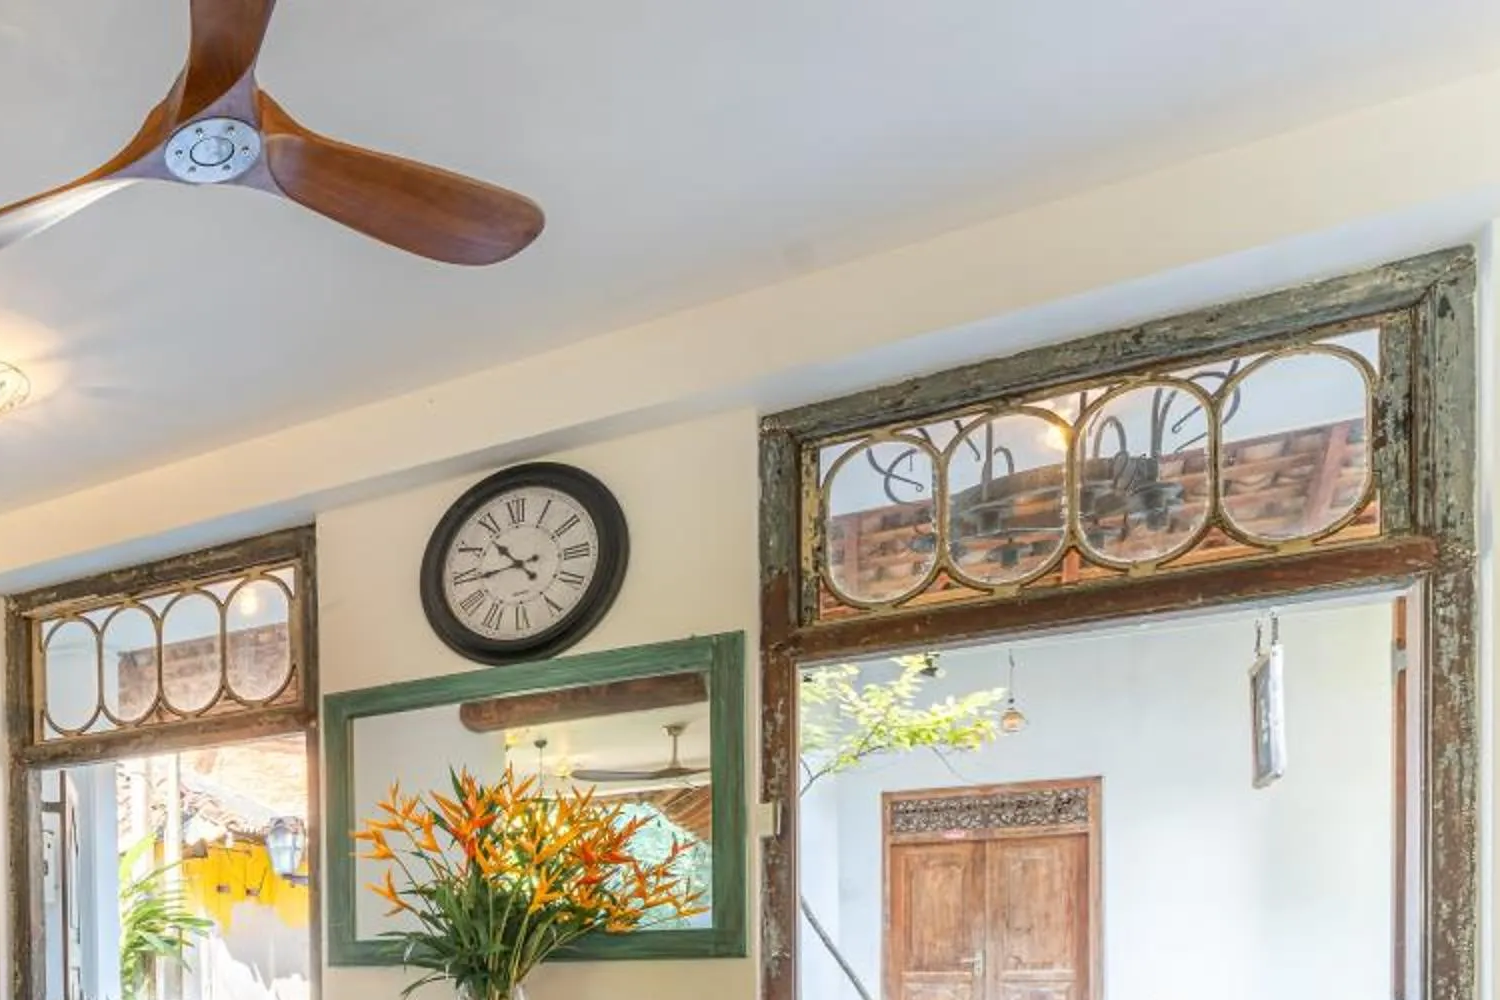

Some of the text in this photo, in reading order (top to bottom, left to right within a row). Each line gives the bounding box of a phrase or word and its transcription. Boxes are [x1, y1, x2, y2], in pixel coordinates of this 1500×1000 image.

[506, 497, 526, 526] XII
[555, 513, 580, 538] II
[563, 541, 590, 561] III
